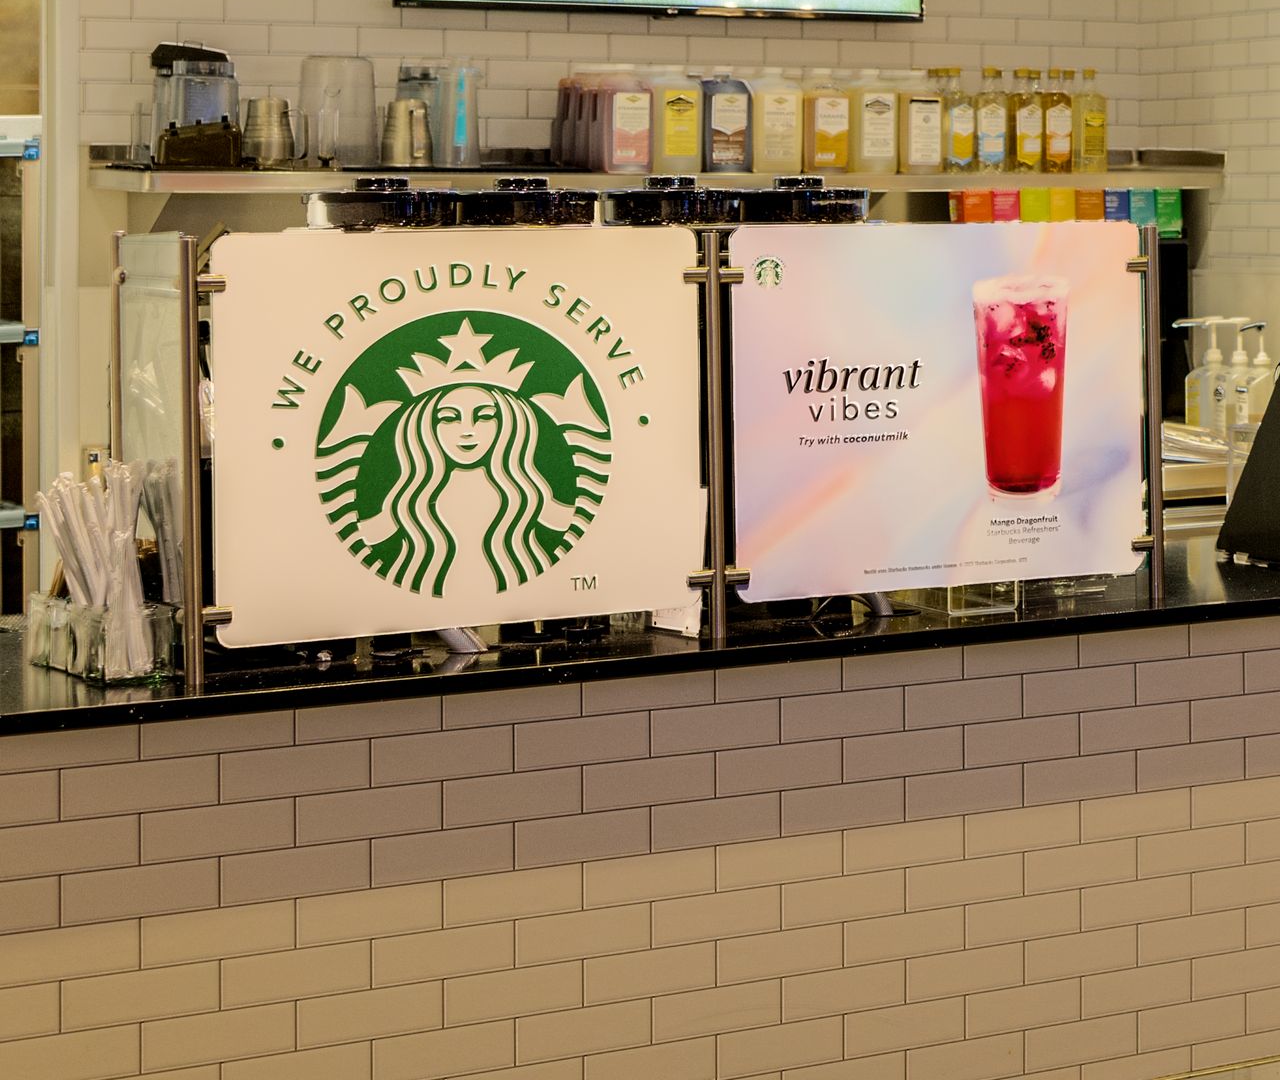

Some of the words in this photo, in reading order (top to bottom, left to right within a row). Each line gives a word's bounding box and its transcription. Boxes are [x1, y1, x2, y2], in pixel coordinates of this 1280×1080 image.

[271, 348, 323, 411] WE
[323, 262, 528, 341] PROUDLY
[543, 283, 647, 391] SERVE
[782, 357, 924, 395] vibrant
[808, 396, 900, 423] vibes
[798, 436, 815, 447] Try
[817, 435, 841, 446] with
[843, 431, 909, 444] coconutmilk
[990, 518, 1016, 527] Mango
[1016, 515, 1058, 526] Dragonfruit
[986, 527, 1021, 537] Starbucks
[1008, 536, 1041, 545] Beverage
[570, 575, 598, 591] TM
